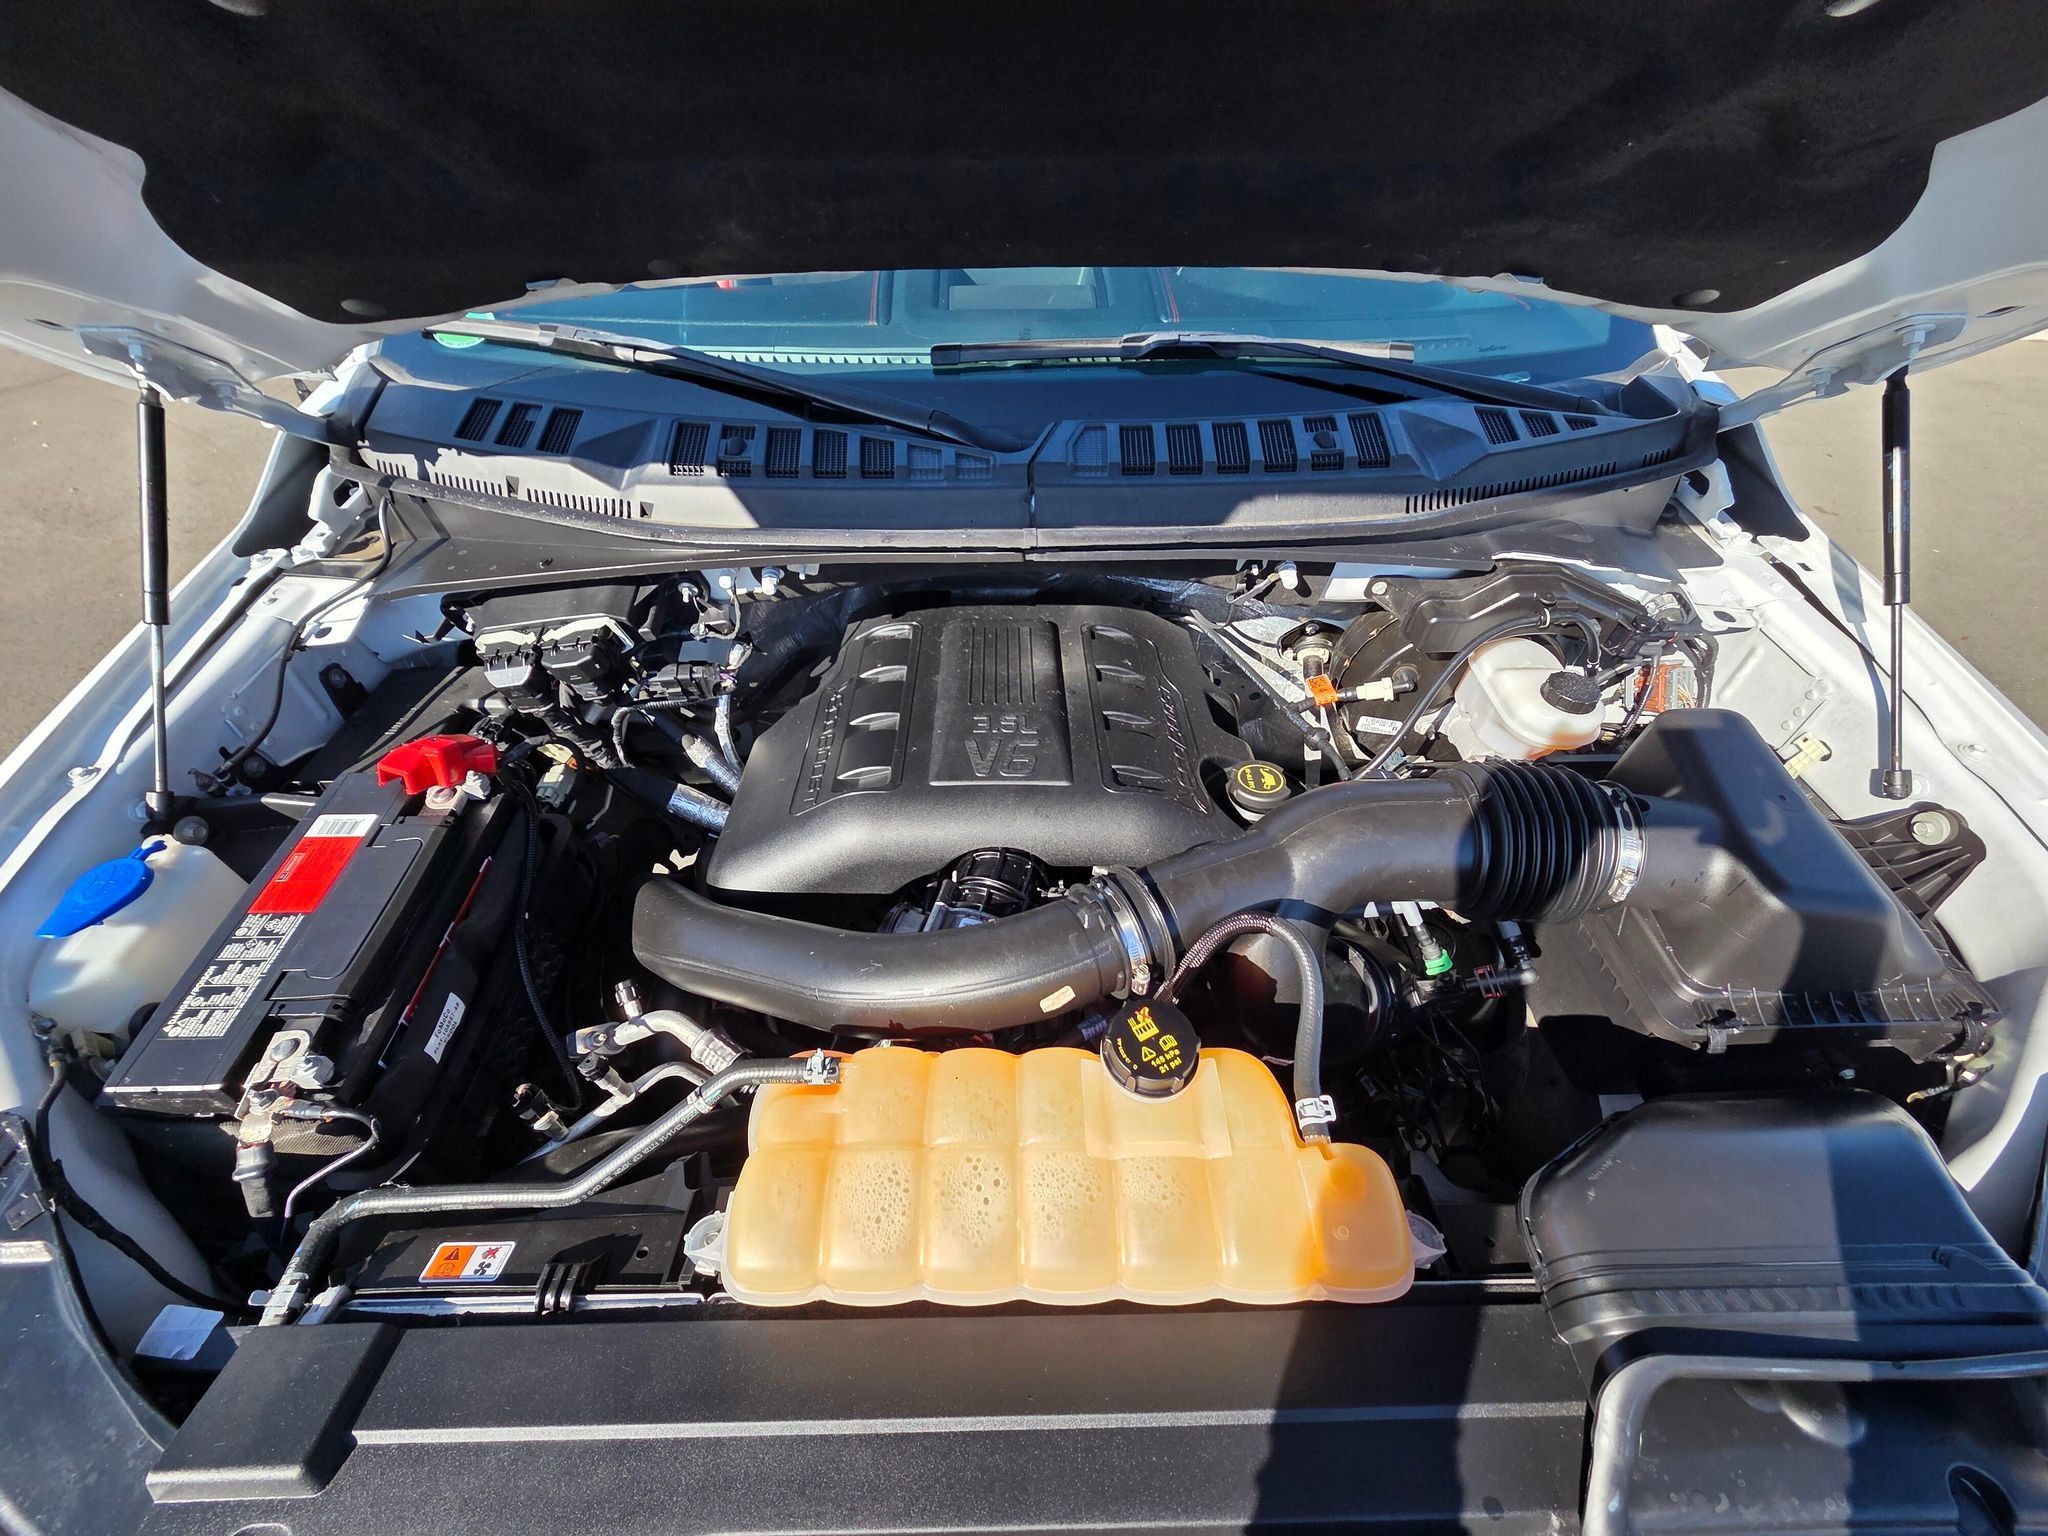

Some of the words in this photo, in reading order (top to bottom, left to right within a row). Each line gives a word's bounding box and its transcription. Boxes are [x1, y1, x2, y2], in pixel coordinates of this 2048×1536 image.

[964, 738, 1040, 776] V6
[434, 1008, 451, 1039] FoMoCo
[1165, 1049, 1181, 1061] kPa
[1159, 1065, 1169, 1074] 21
